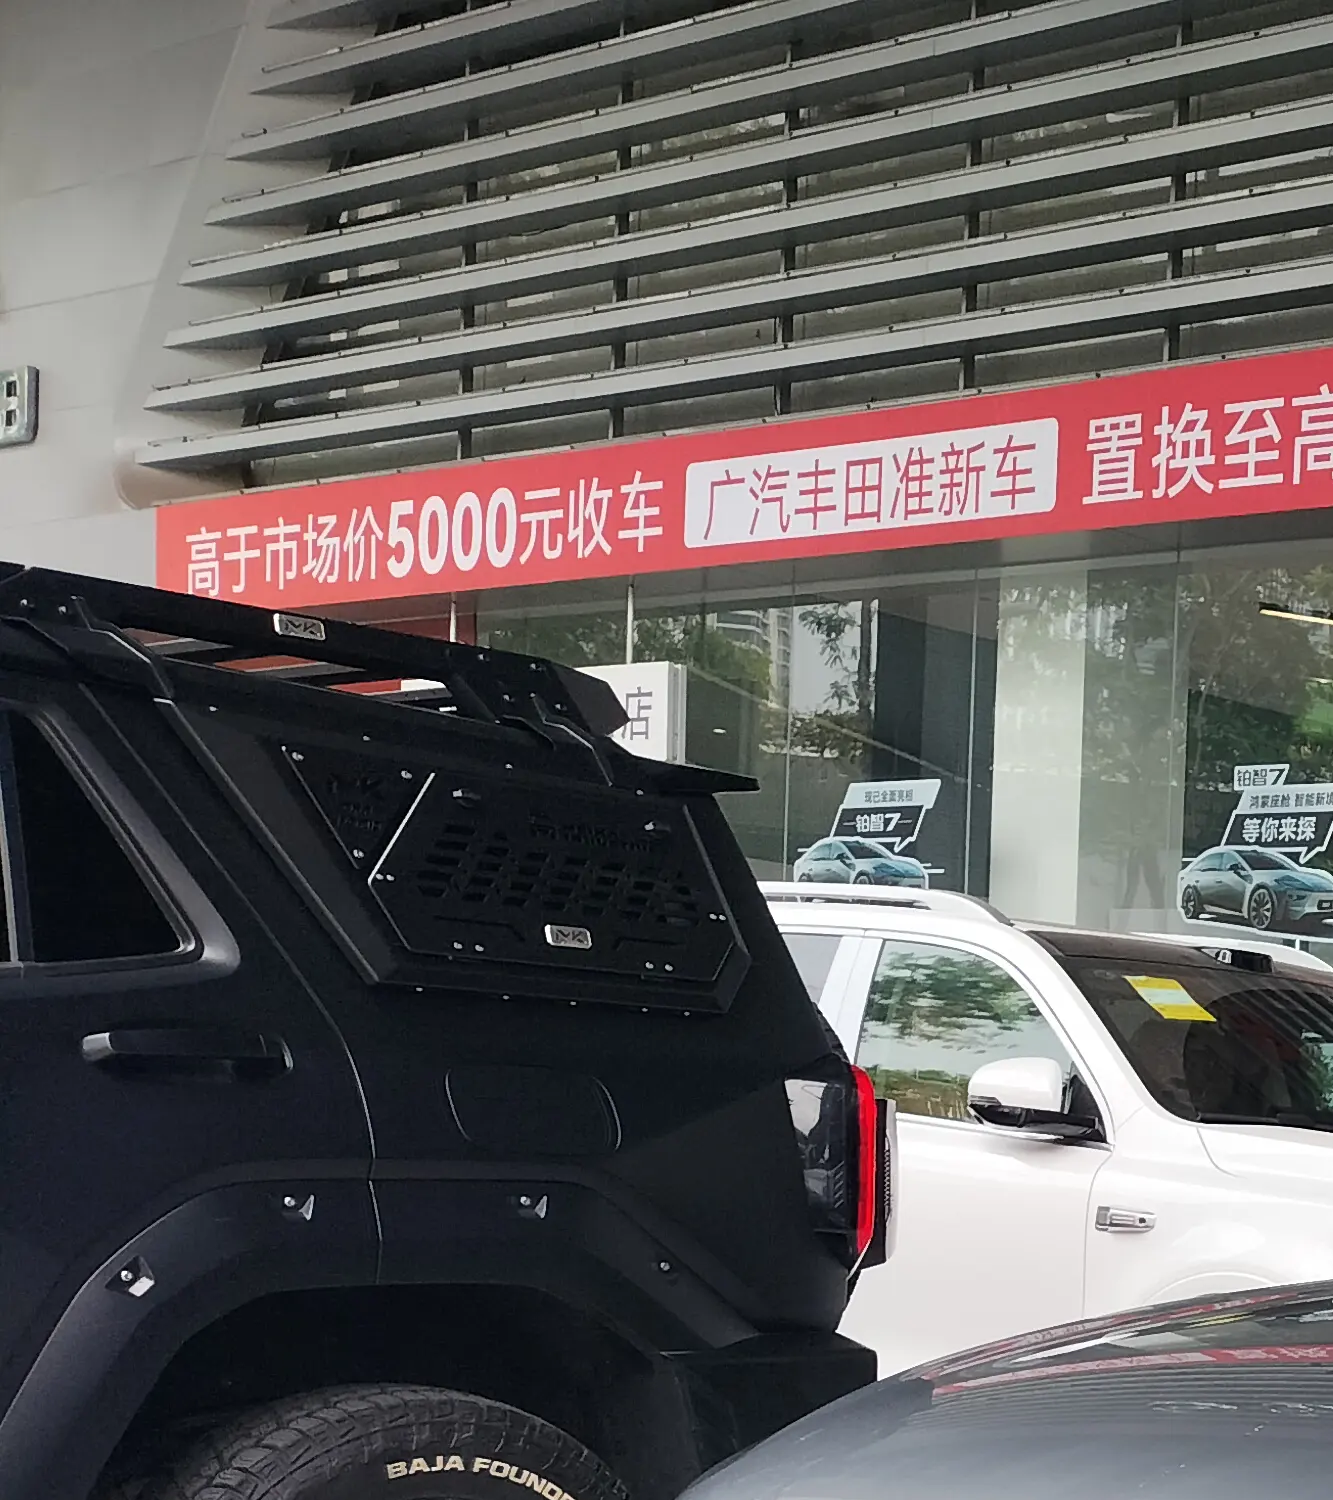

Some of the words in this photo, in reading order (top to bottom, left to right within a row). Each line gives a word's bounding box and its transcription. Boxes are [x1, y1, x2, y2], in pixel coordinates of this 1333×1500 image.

[184, 470, 665, 597] 高于市场价5000元收车
[703, 433, 1037, 540] 广汽丰田准新车
[1237, 768, 1286, 787] 铂智7
[855, 813, 902, 832] 铂智7
[1242, 816, 1317, 843] 等你来探
[386, 1455, 465, 1480] BAJA
